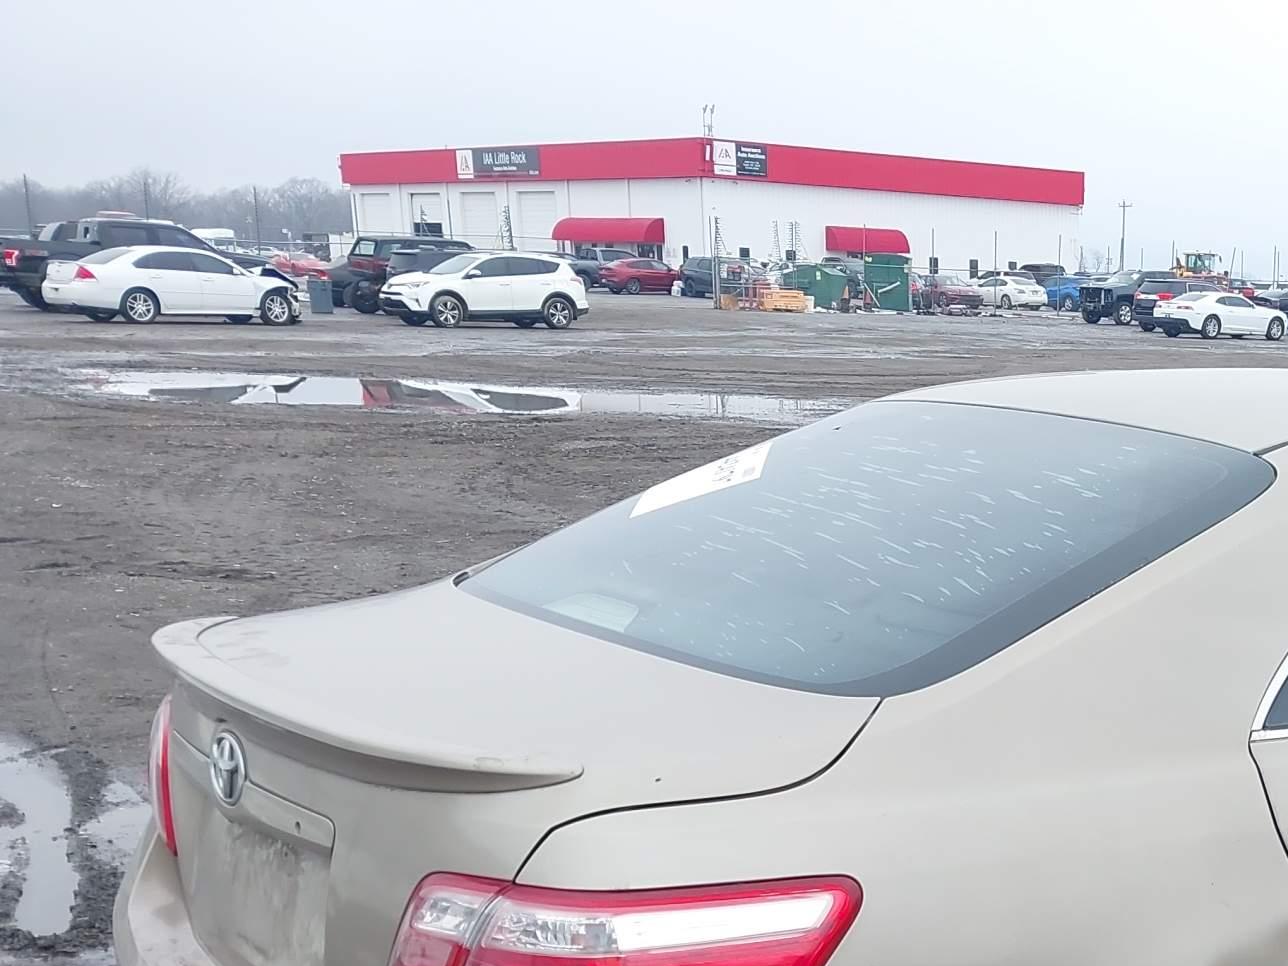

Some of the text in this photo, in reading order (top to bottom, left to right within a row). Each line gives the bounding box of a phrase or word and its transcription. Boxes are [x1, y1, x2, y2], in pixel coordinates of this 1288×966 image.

[483, 151, 527, 165] IAA Little Rock
